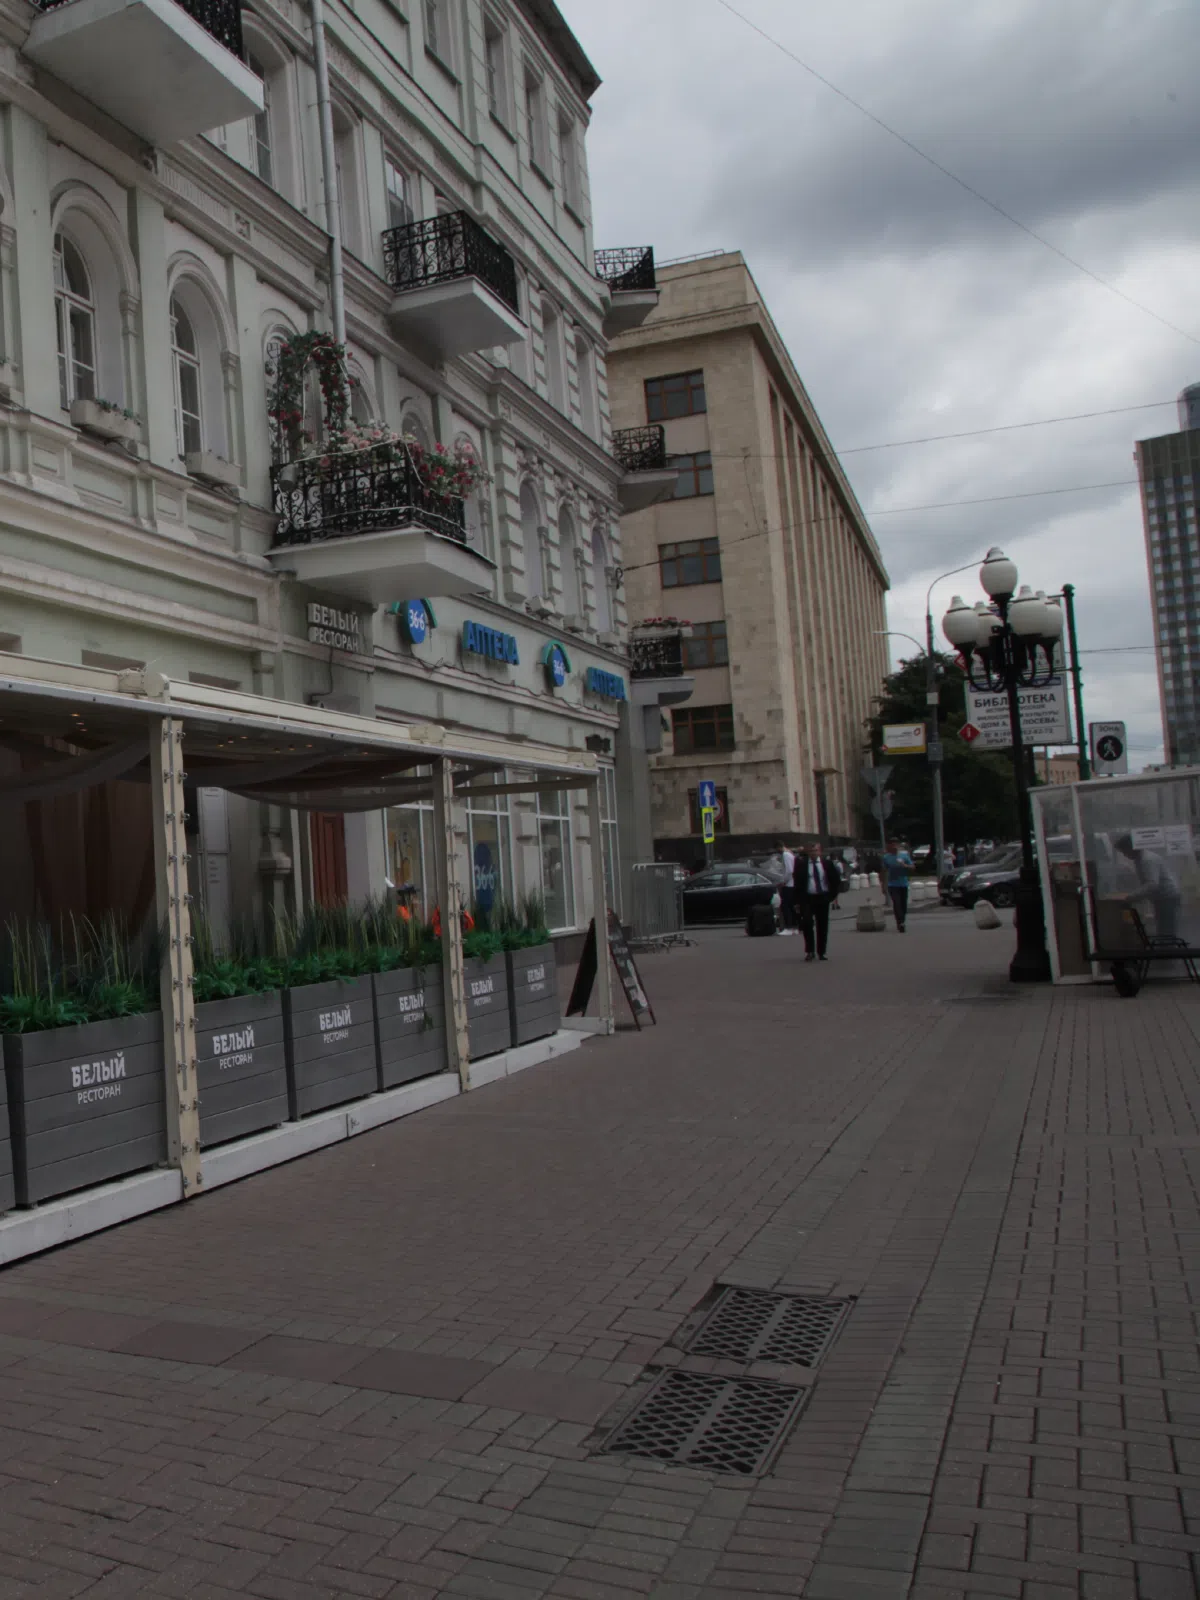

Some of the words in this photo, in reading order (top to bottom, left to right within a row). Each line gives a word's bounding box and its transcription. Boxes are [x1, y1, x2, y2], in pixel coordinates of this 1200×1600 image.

[311, 603, 360, 634] БЕЛЫЙ
[313, 628, 359, 652] РЕСТОРАН
[464, 620, 520, 665] АПТЕКА
[588, 667, 626, 699] АПТЕКА
[974, 693, 1056, 708] БИБЛОТЕКА
[1099, 725, 1120, 733] ЗОНА
[471, 976, 494, 996] БЕЛЫЙ
[398, 989, 425, 1012] БЕЛЫЙ
[319, 1004, 352, 1031] БЕЛЫЙ
[212, 1025, 255, 1055] БЕЛЫЙ
[323, 1029, 349, 1043] РЕСТОРАН
[71, 1051, 126, 1088] БЕЛЫЙ
[219, 1052, 253, 1070] РЕСТОРАН
[77, 1083, 121, 1104] РЕСТОРАН
